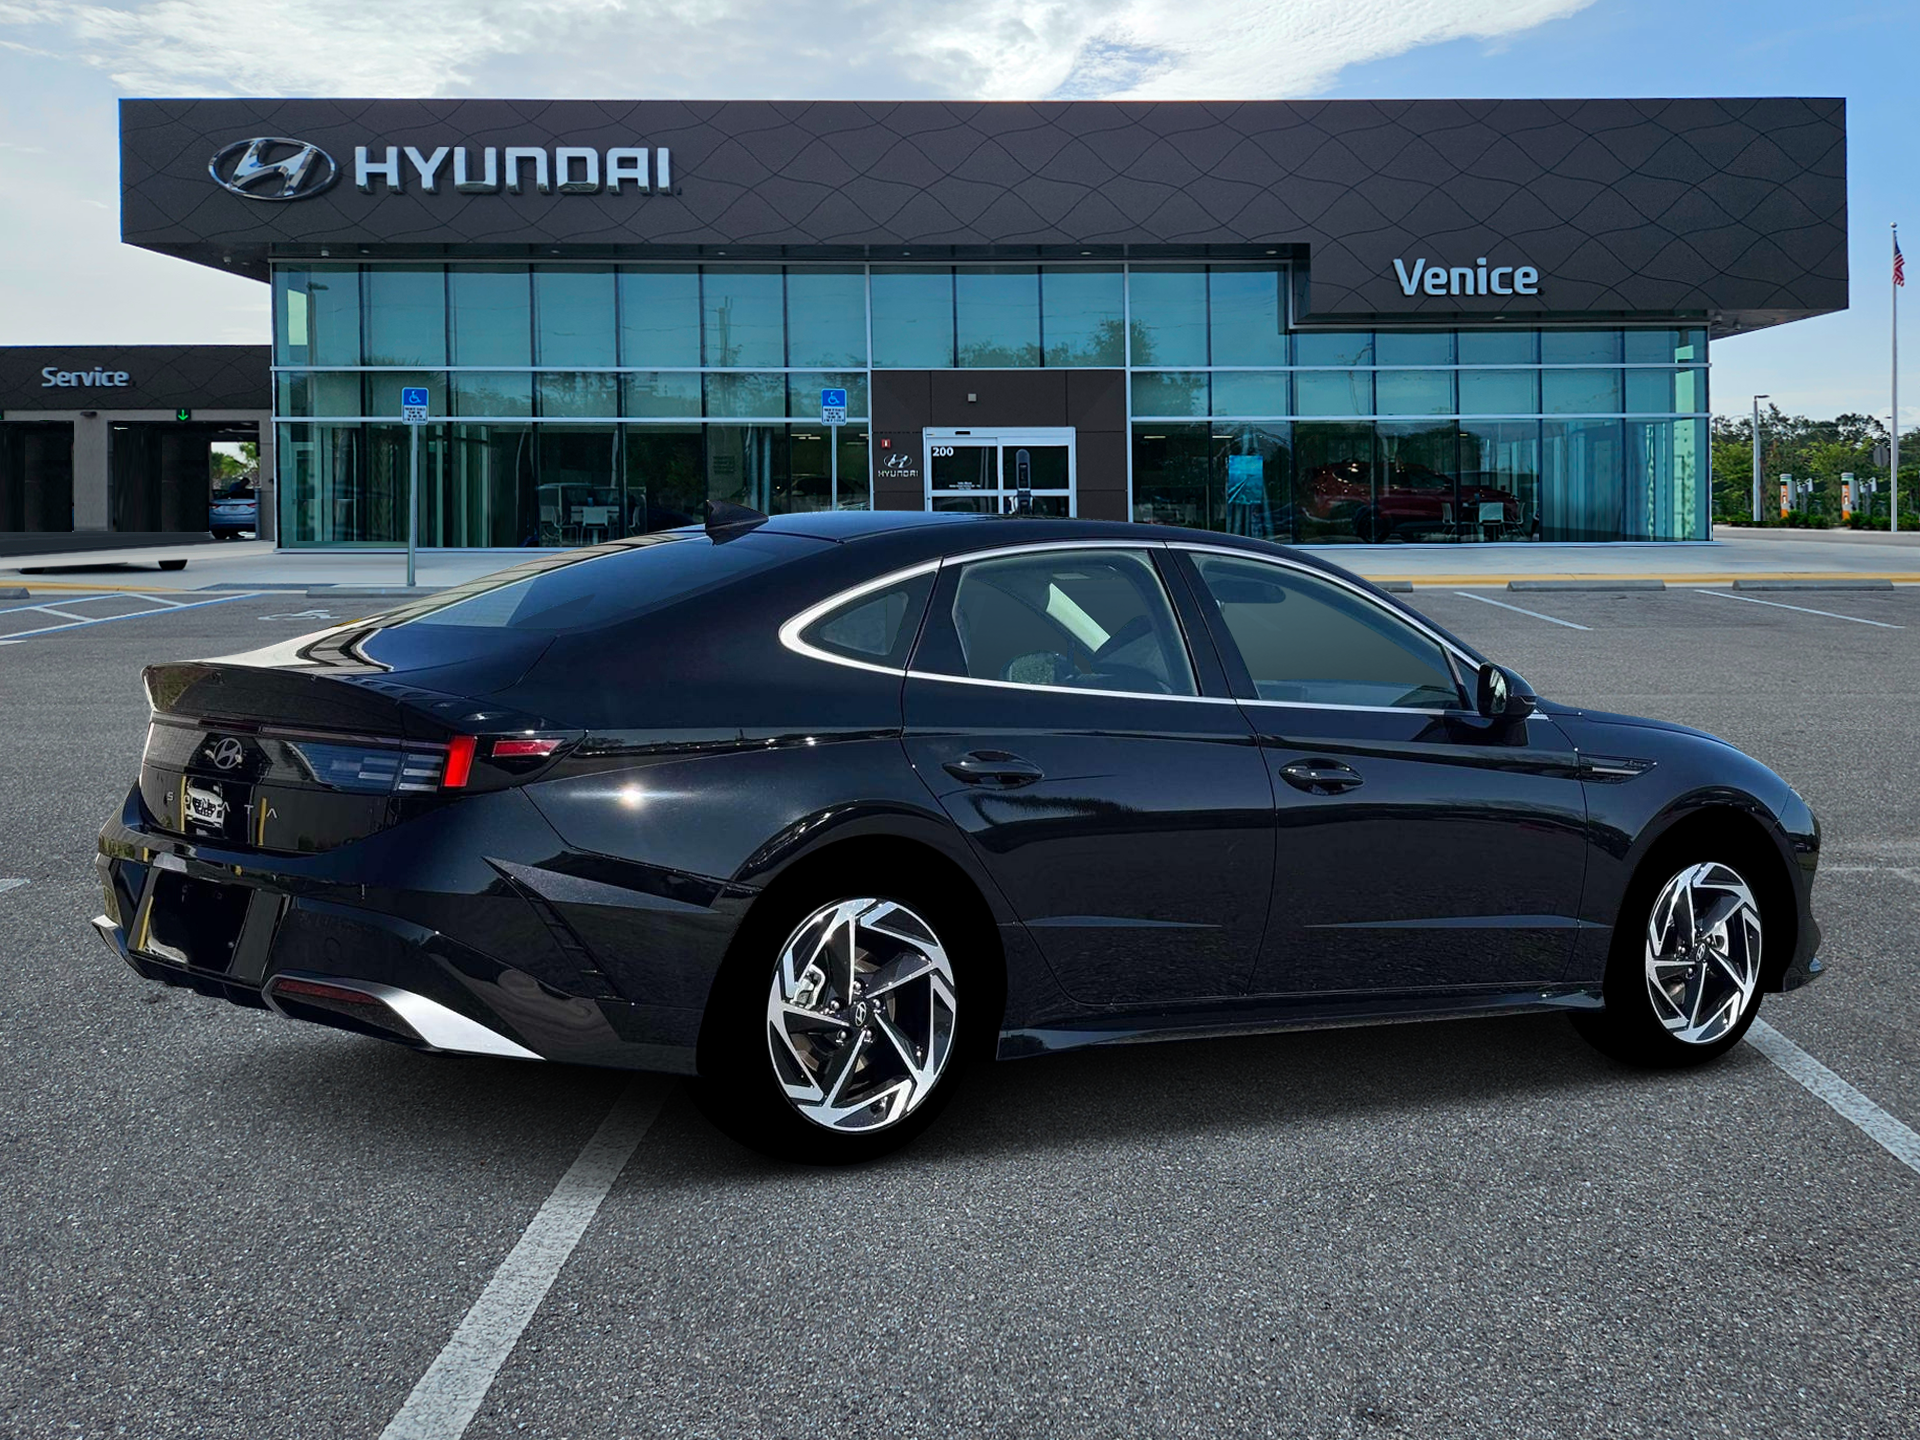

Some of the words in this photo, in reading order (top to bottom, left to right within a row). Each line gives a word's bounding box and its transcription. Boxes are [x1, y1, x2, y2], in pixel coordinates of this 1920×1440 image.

[354, 146, 672, 195] HYUNDAI
[1393, 257, 1539, 296] Venice
[42, 366, 130, 387] Service
[932, 446, 954, 457] 200
[878, 469, 919, 478] HYUNDAI
